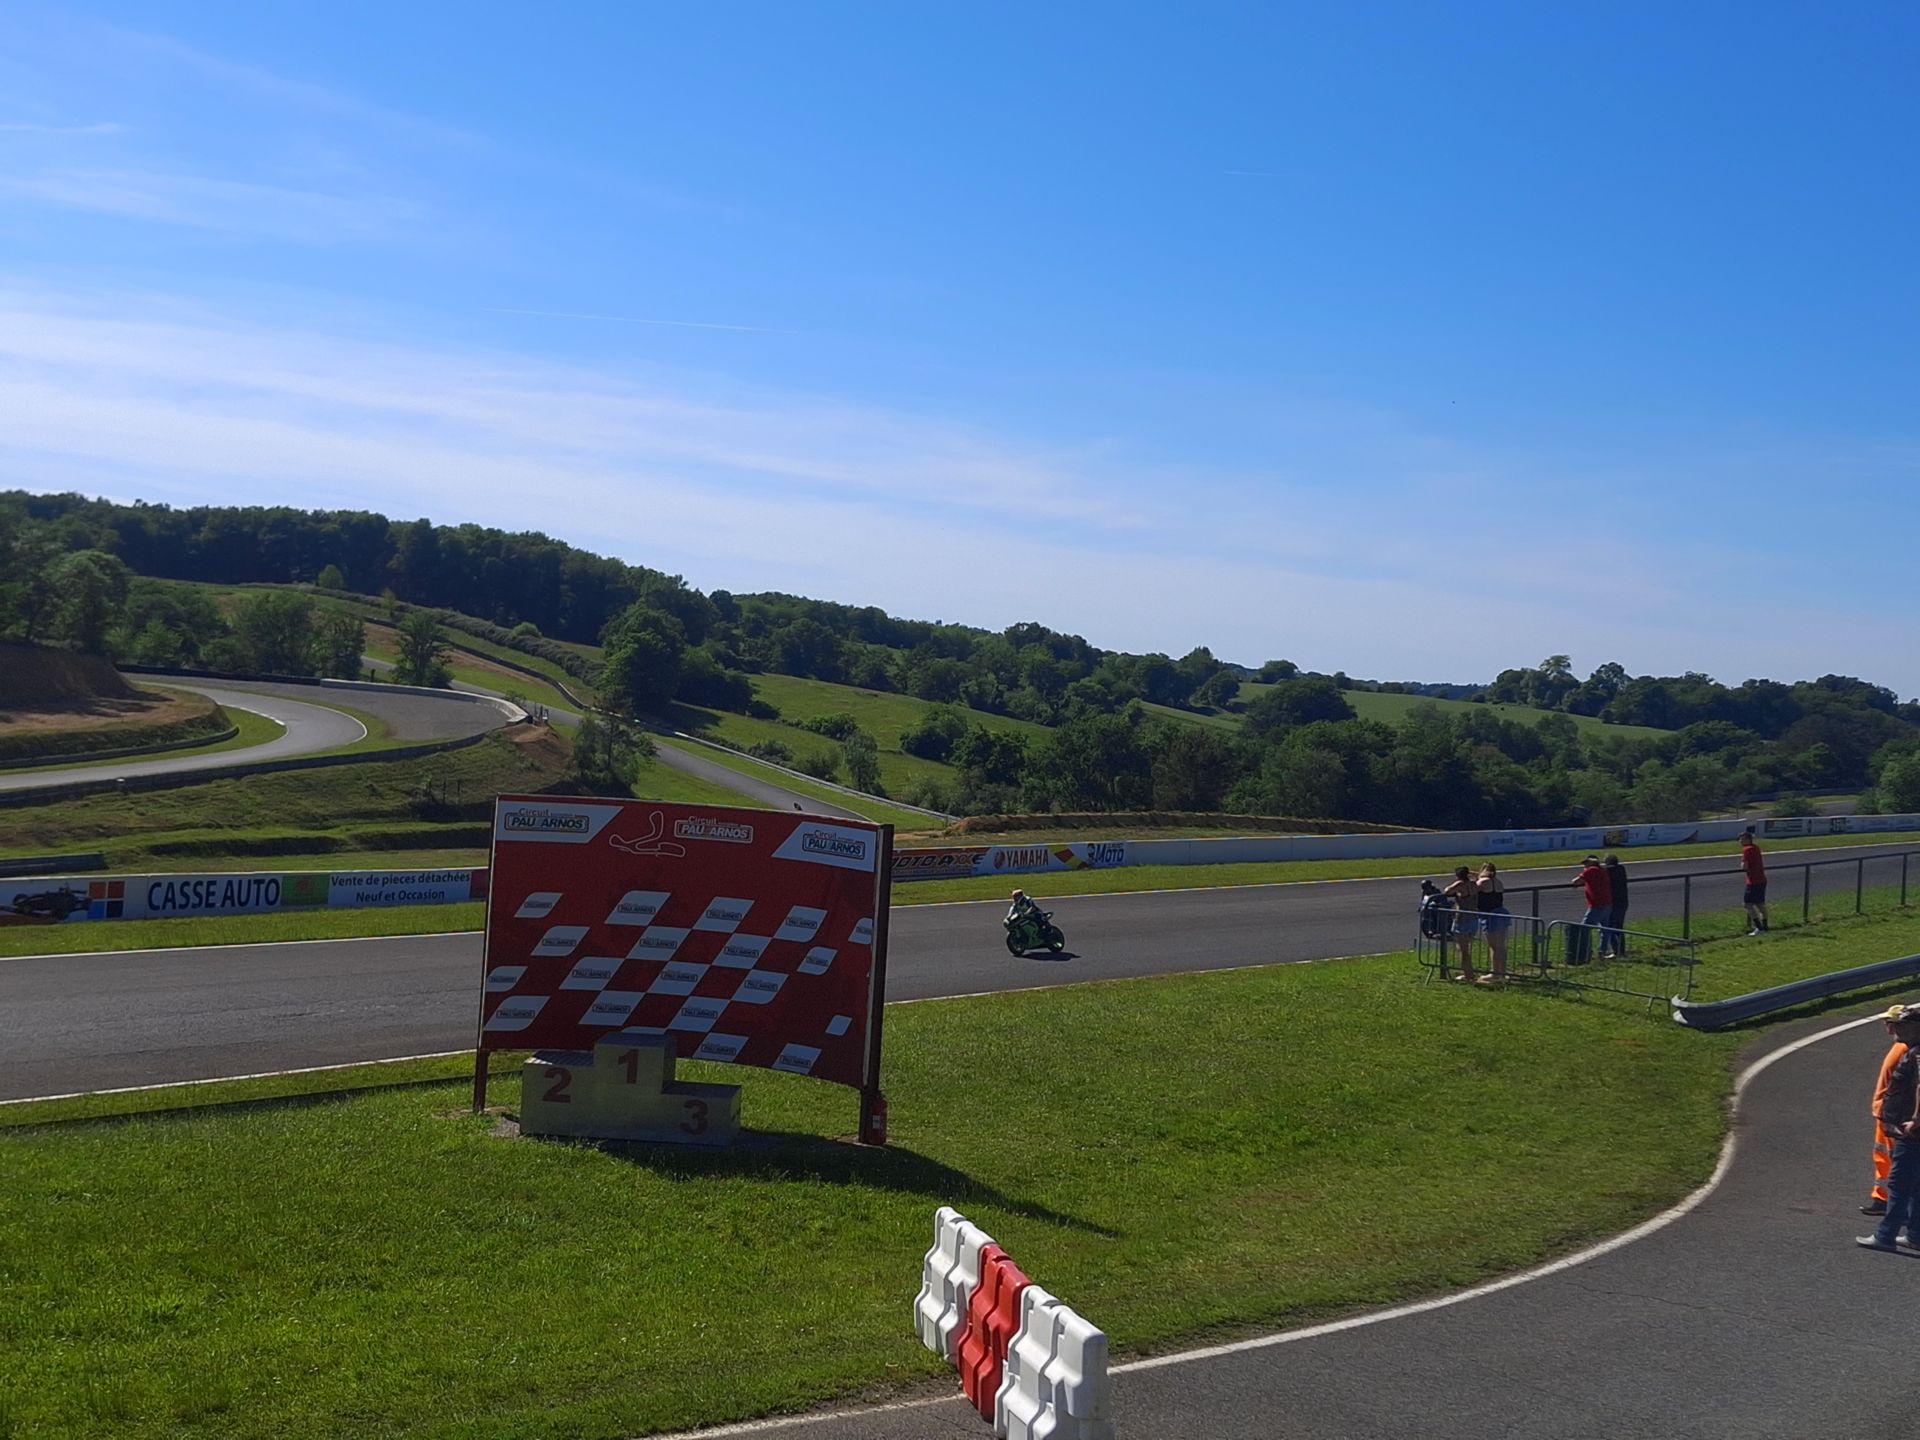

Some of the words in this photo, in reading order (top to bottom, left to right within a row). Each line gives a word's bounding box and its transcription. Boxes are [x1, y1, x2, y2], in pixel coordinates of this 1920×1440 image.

[518, 808, 549, 817] Circuit
[511, 817, 536, 827] PAU
[540, 818, 584, 829] ARNOS
[688, 816, 717, 825] Circuit
[681, 825, 704, 835] PAU
[710, 827, 749, 839] ARNOS
[814, 830, 837, 839] Circuit
[808, 839, 827, 849] PAU
[830, 842, 861, 854] ARNOS
[1005, 849, 1049, 867] YAMAHA
[331, 876, 363, 887] Vente
[365, 874, 379, 886] de
[418, 870, 470, 884] détachées
[148, 880, 217, 911] CASSE
[220, 878, 280, 908] AUTO
[356, 891, 383, 902] Neuf
[385, 892, 395, 901] et
[399, 890, 445, 901] Occasion
[617, 1050, 639, 1085] 1
[543, 1067, 572, 1104] 2
[680, 1100, 709, 1135] 3
